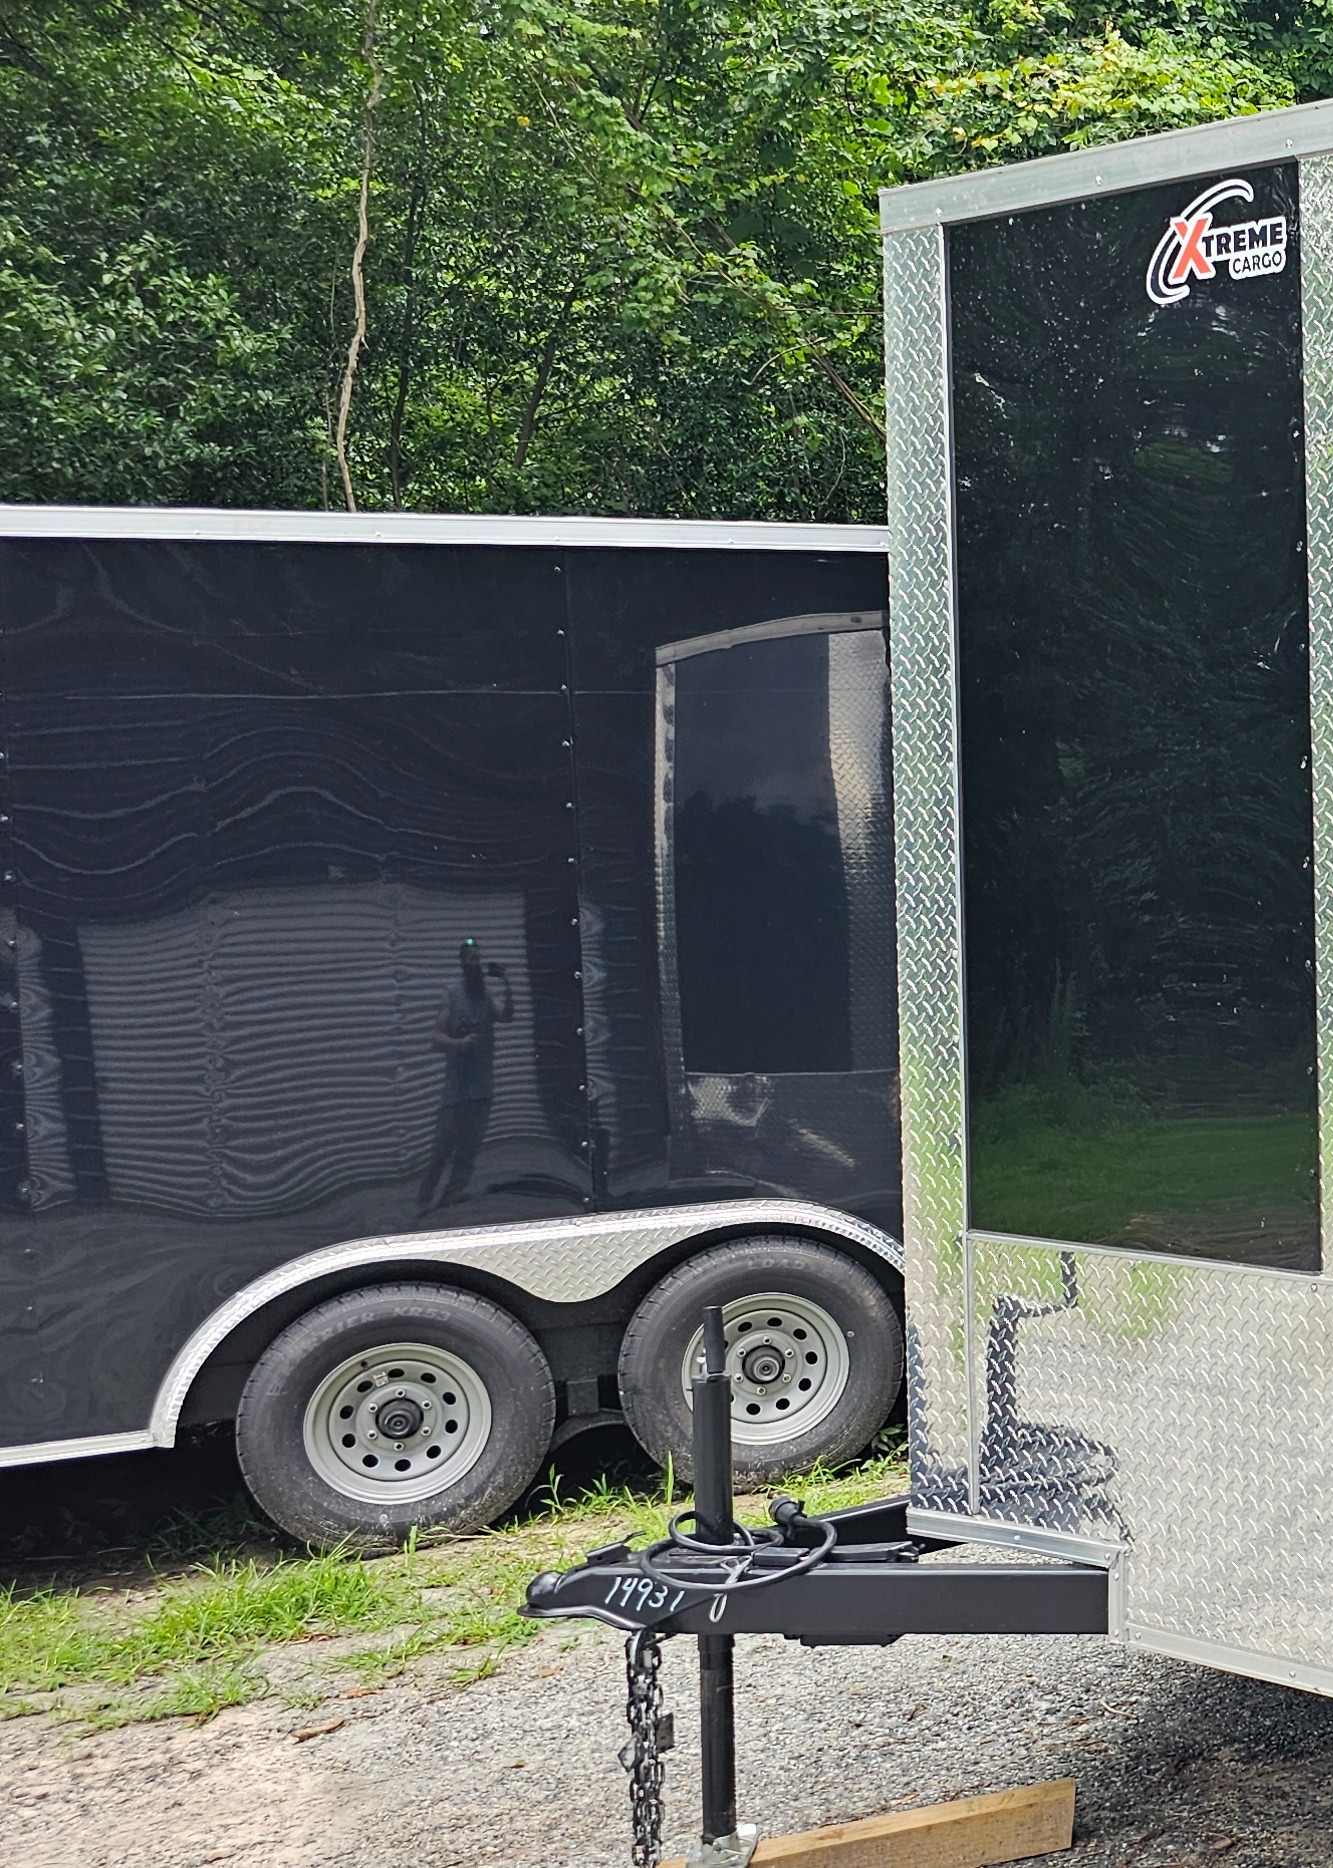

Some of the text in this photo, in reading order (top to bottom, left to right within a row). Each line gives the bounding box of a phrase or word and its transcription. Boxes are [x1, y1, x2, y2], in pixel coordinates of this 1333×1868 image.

[1172, 217, 1284, 279] XTREME
[1232, 250, 1283, 275] CARGO
[605, 1576, 685, 1612] 14931
